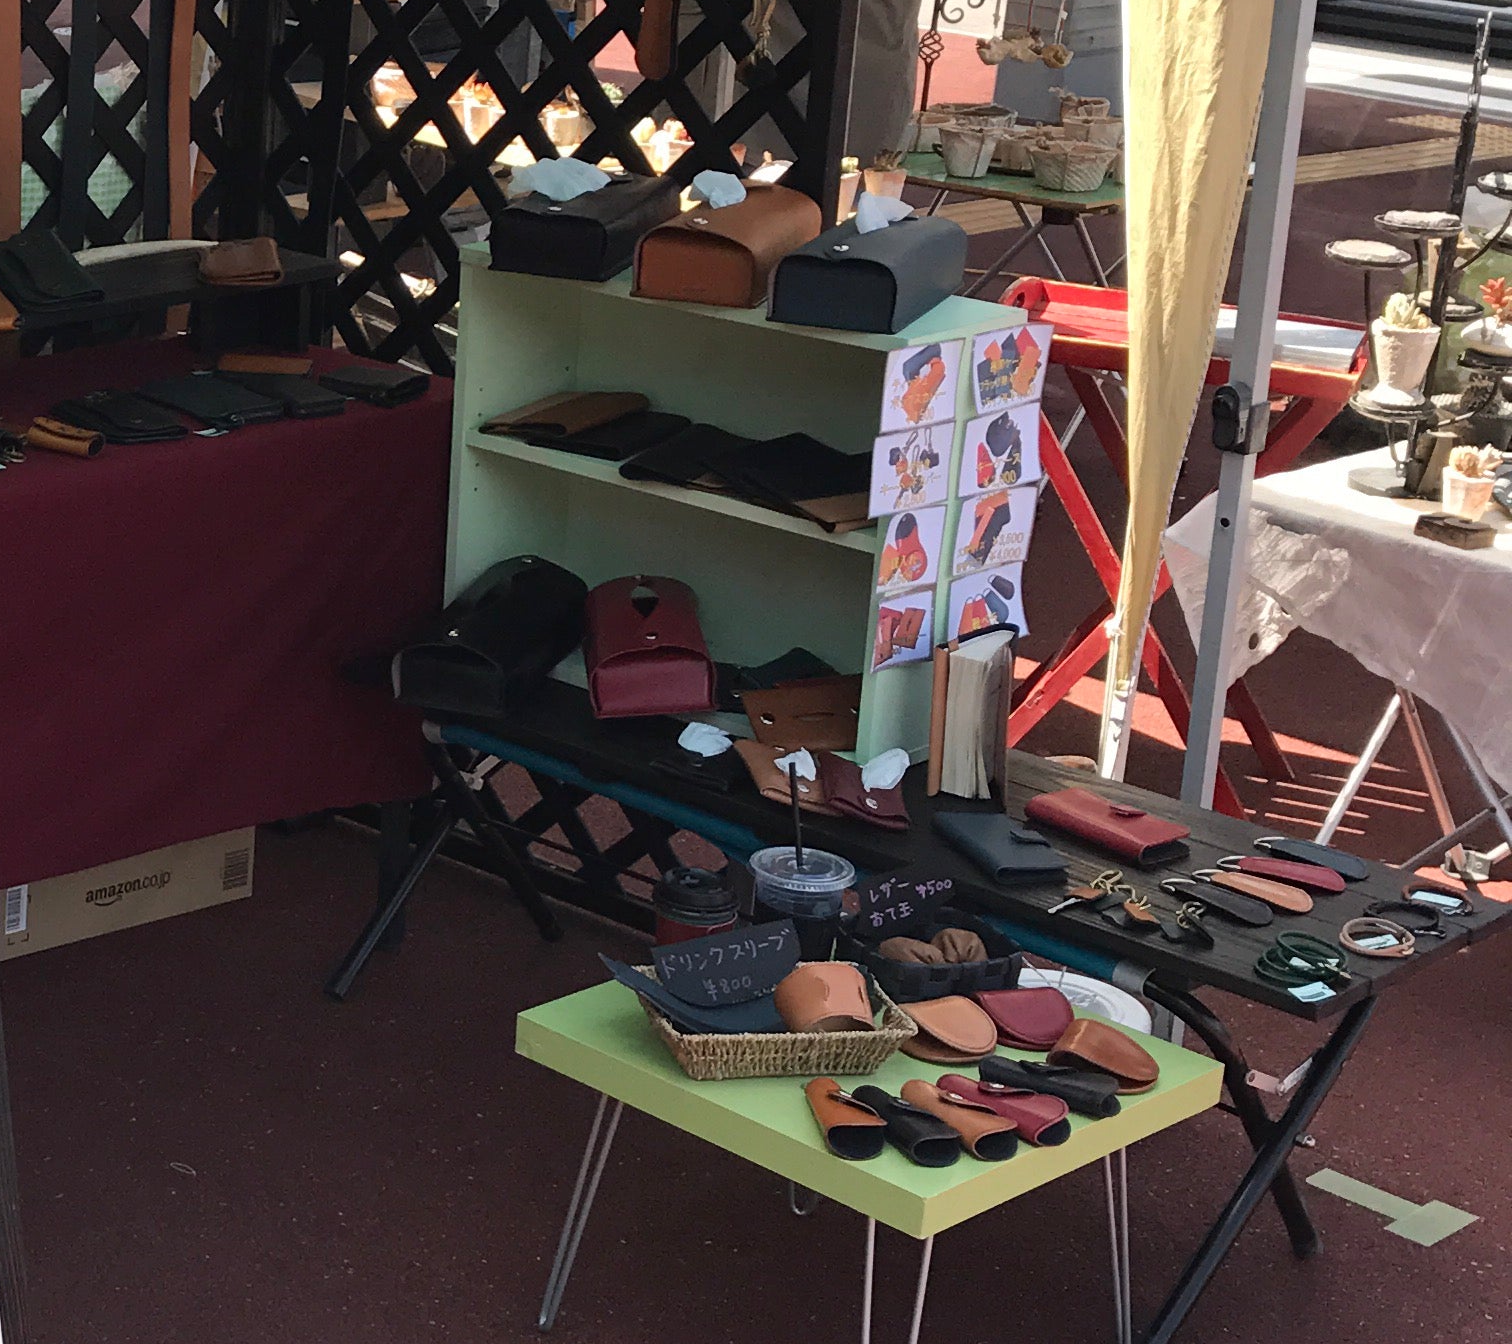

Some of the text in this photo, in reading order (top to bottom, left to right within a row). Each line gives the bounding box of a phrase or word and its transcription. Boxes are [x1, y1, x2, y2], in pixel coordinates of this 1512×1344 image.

[868, 876, 954, 904] レザー ¥500
[658, 927, 791, 980] ドリンクスリーブ
[702, 975, 752, 1002] ¥800
